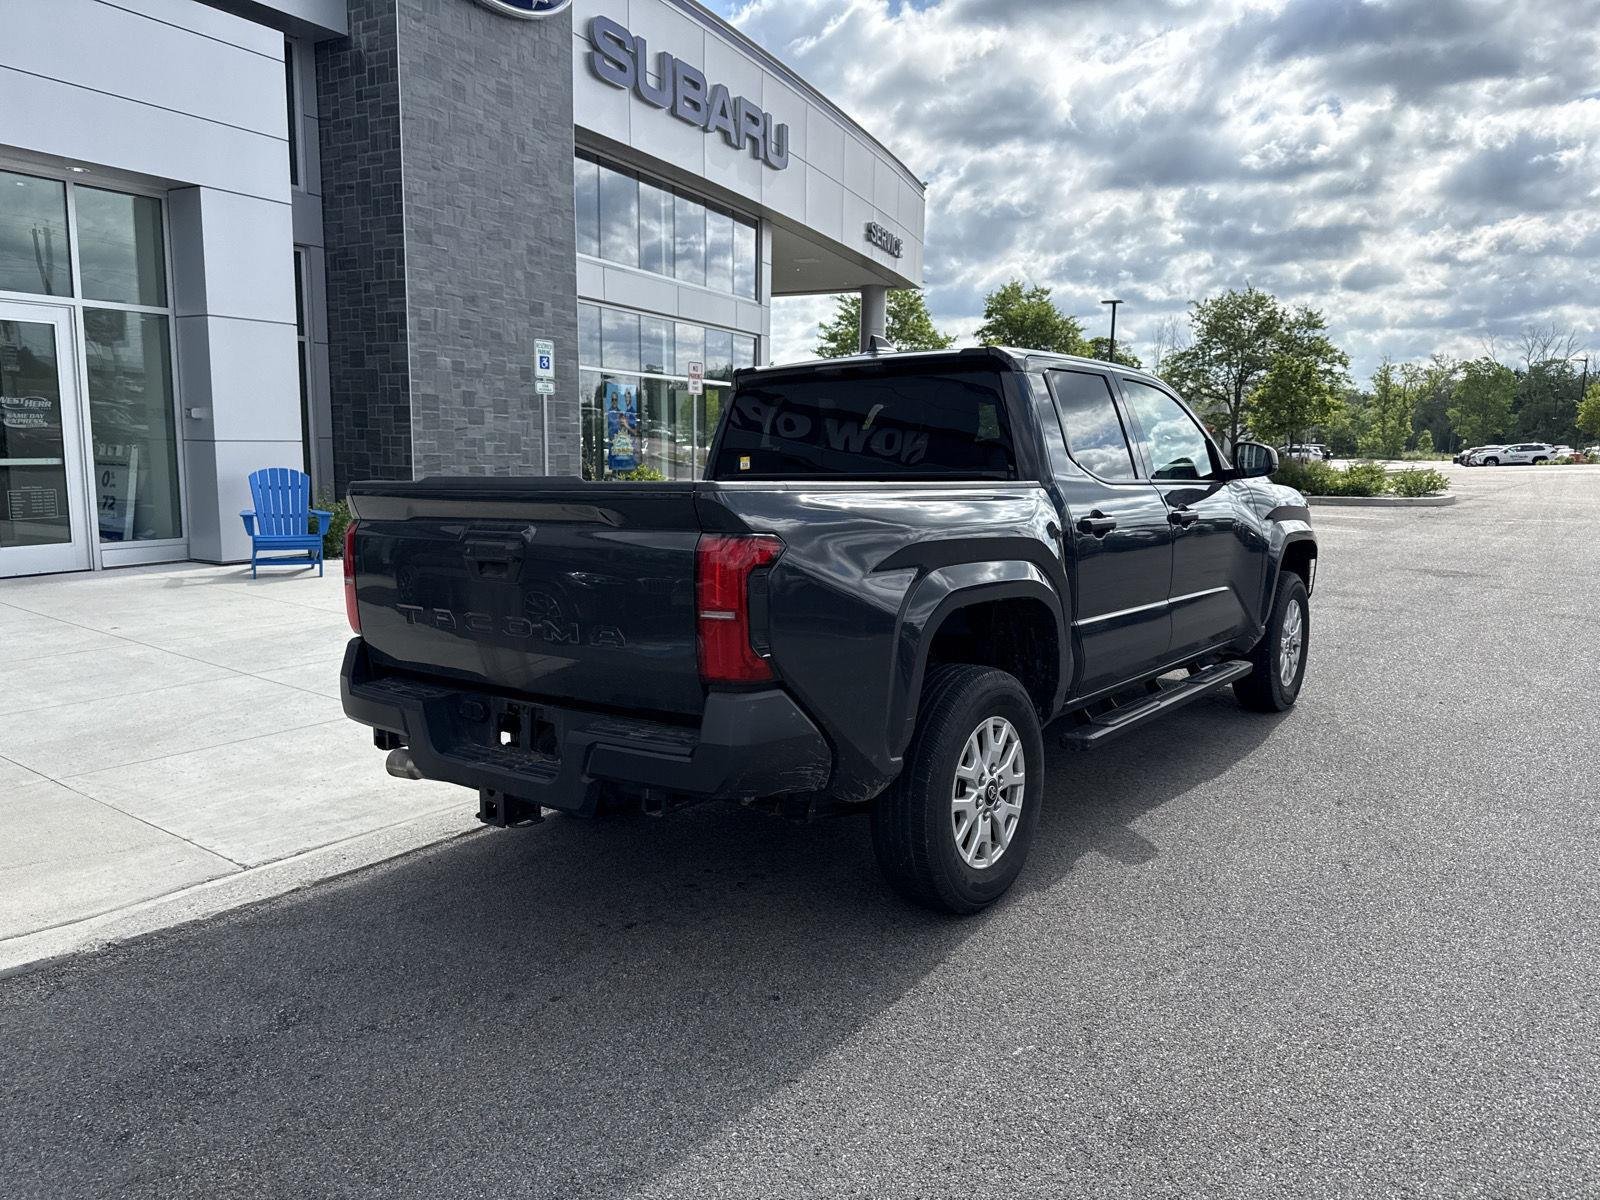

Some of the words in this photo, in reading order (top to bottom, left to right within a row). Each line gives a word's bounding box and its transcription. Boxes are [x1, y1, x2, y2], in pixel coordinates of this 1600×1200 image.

[588, 15, 789, 170] SUBARU
[866, 221, 904, 258] SERVICE
[24, 399, 52, 408] HERR
[102, 495, 116, 511] 72
[396, 602, 627, 649] TACOMA
